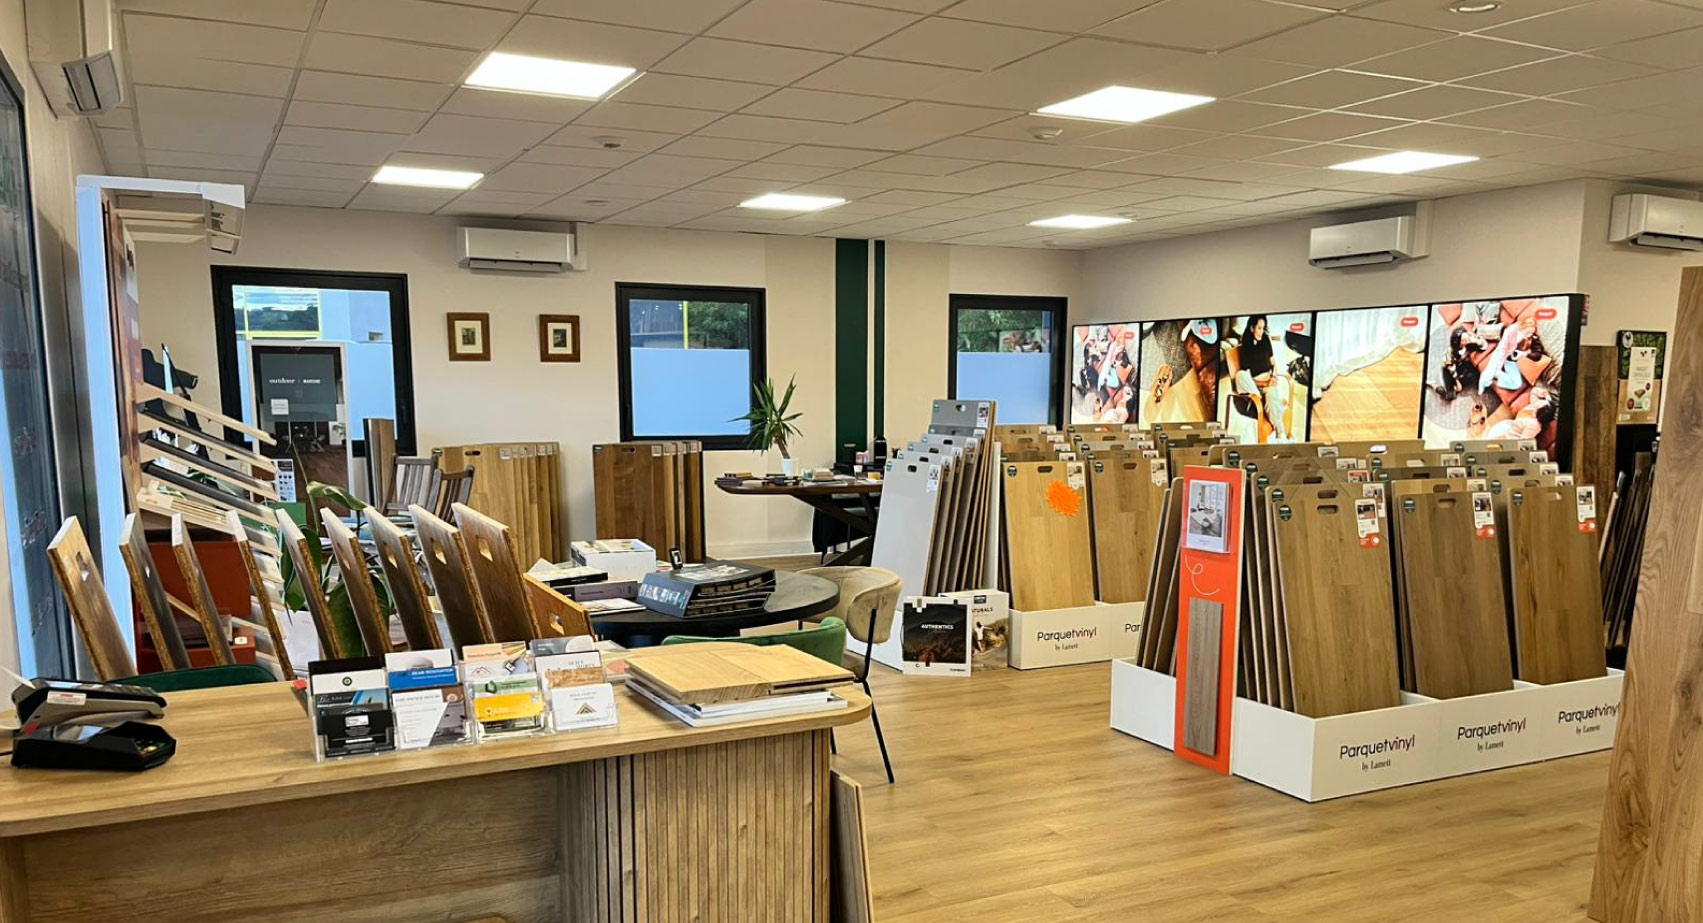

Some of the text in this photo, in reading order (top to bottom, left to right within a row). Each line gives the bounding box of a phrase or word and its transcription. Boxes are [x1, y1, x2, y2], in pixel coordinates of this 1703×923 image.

[1037, 626, 1097, 642] Parquetvinyl
[1457, 717, 1527, 740] Parquetvinyl
[1339, 734, 1416, 760] Parquetvinyl
